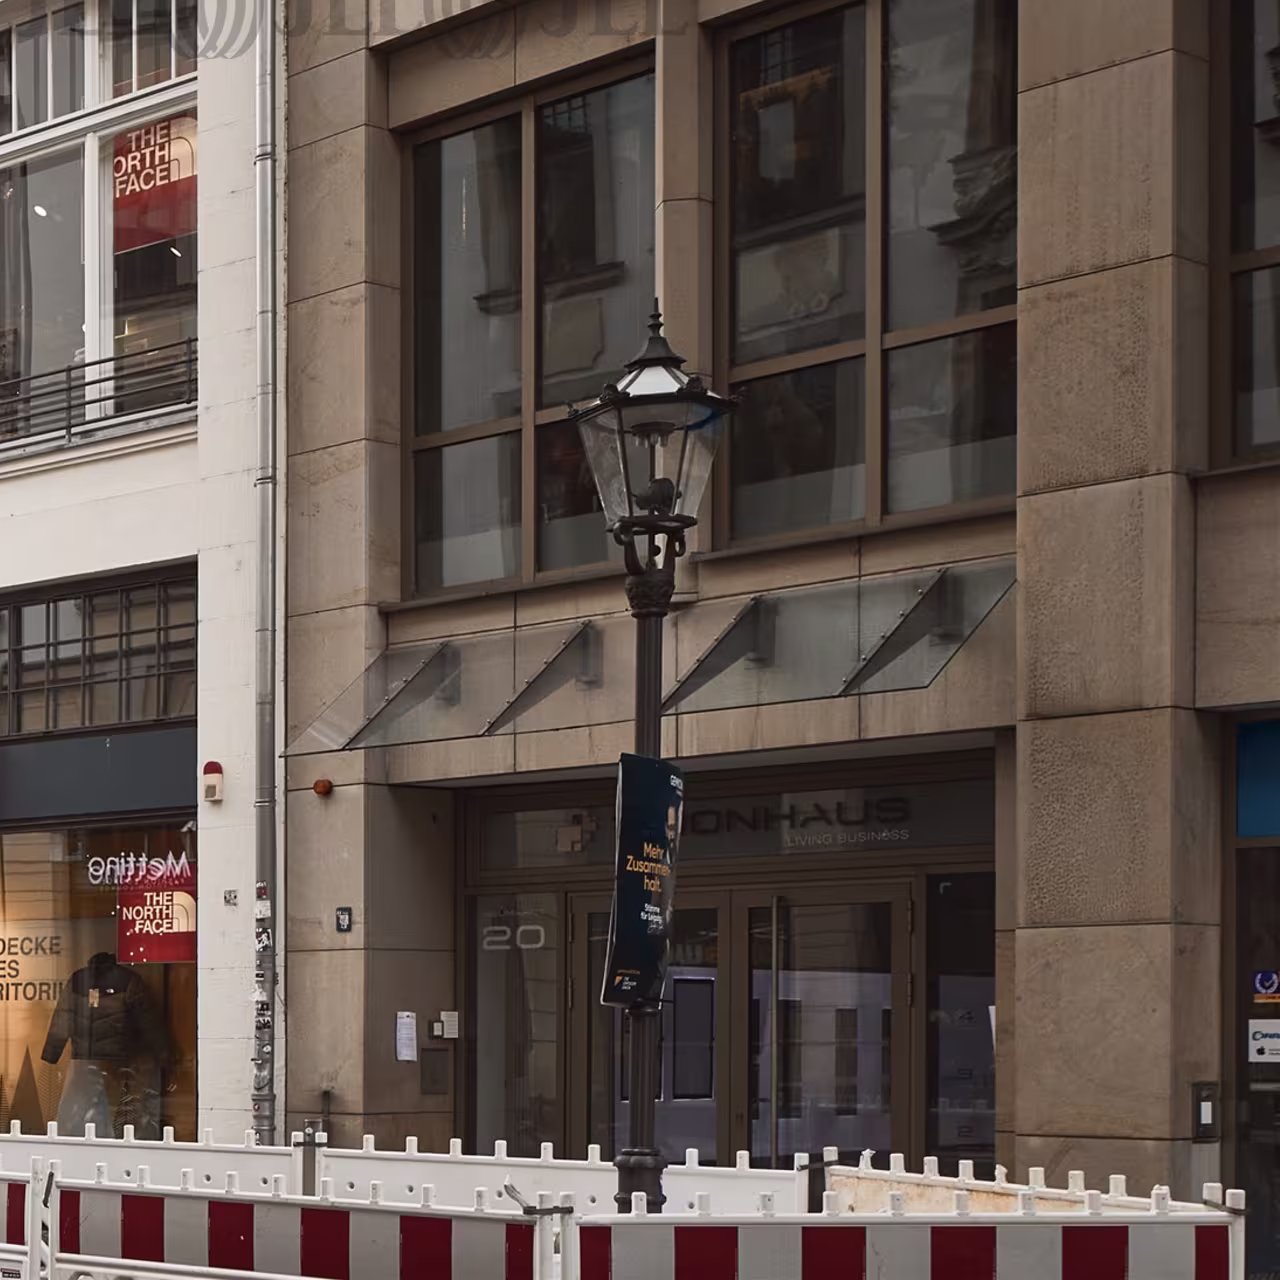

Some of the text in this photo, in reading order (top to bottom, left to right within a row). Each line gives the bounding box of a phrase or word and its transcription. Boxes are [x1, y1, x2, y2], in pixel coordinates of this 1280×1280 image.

[127, 121, 170, 154] THE
[114, 142, 170, 178] ORTH
[115, 164, 170, 198] FACE
[786, 828, 910, 846] LIVING BUSINESS
[643, 840, 664, 860] Mehr
[143, 891, 173, 906] THE
[122, 906, 173, 921] NORTH
[134, 920, 173, 934] FACE
[482, 925, 545, 950] 20
